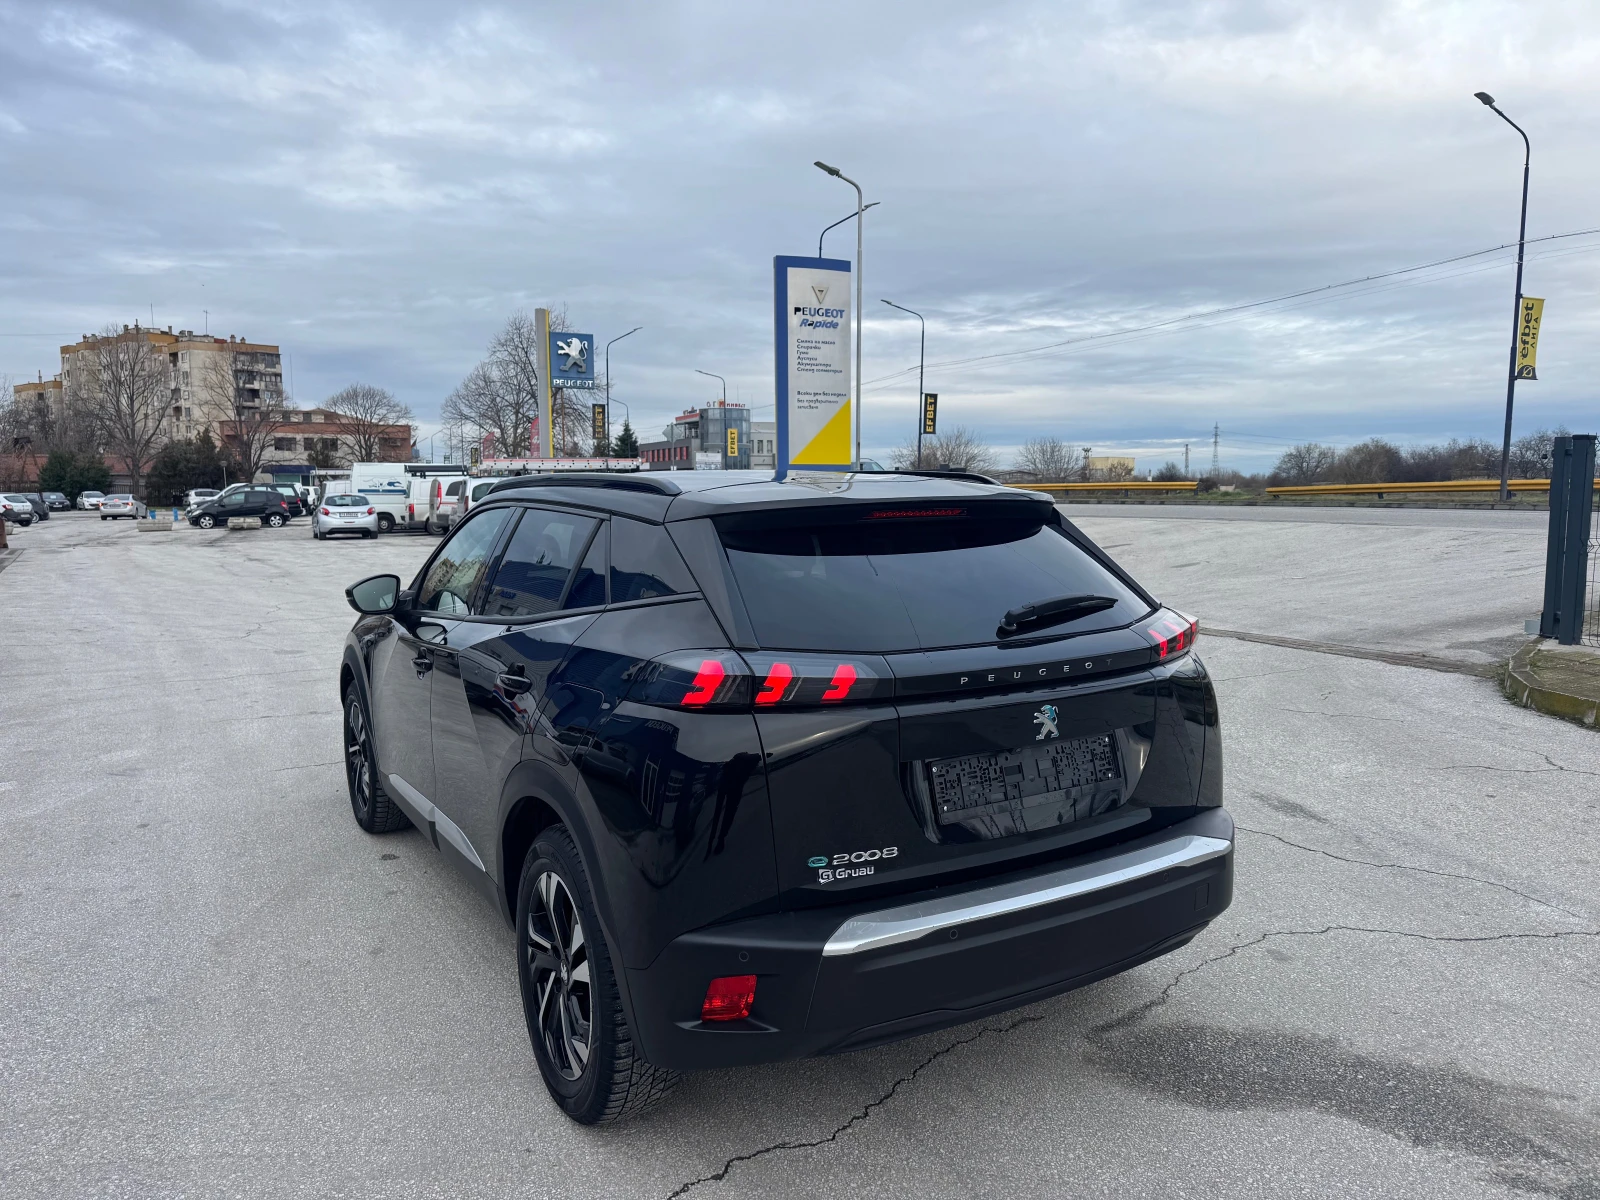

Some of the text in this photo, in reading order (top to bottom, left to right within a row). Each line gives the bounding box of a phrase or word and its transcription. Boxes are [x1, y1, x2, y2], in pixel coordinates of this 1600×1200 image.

[794, 306, 845, 318] PEUGEOT
[800, 318, 839, 329] Rapide
[1520, 302, 1534, 358] efbet
[553, 378, 594, 388] PEUGEOT
[595, 405, 603, 438] EFBET
[926, 396, 935, 432] EFBET
[960, 658, 1112, 685] PEUGEOT
[835, 865, 875, 879] Gruau
